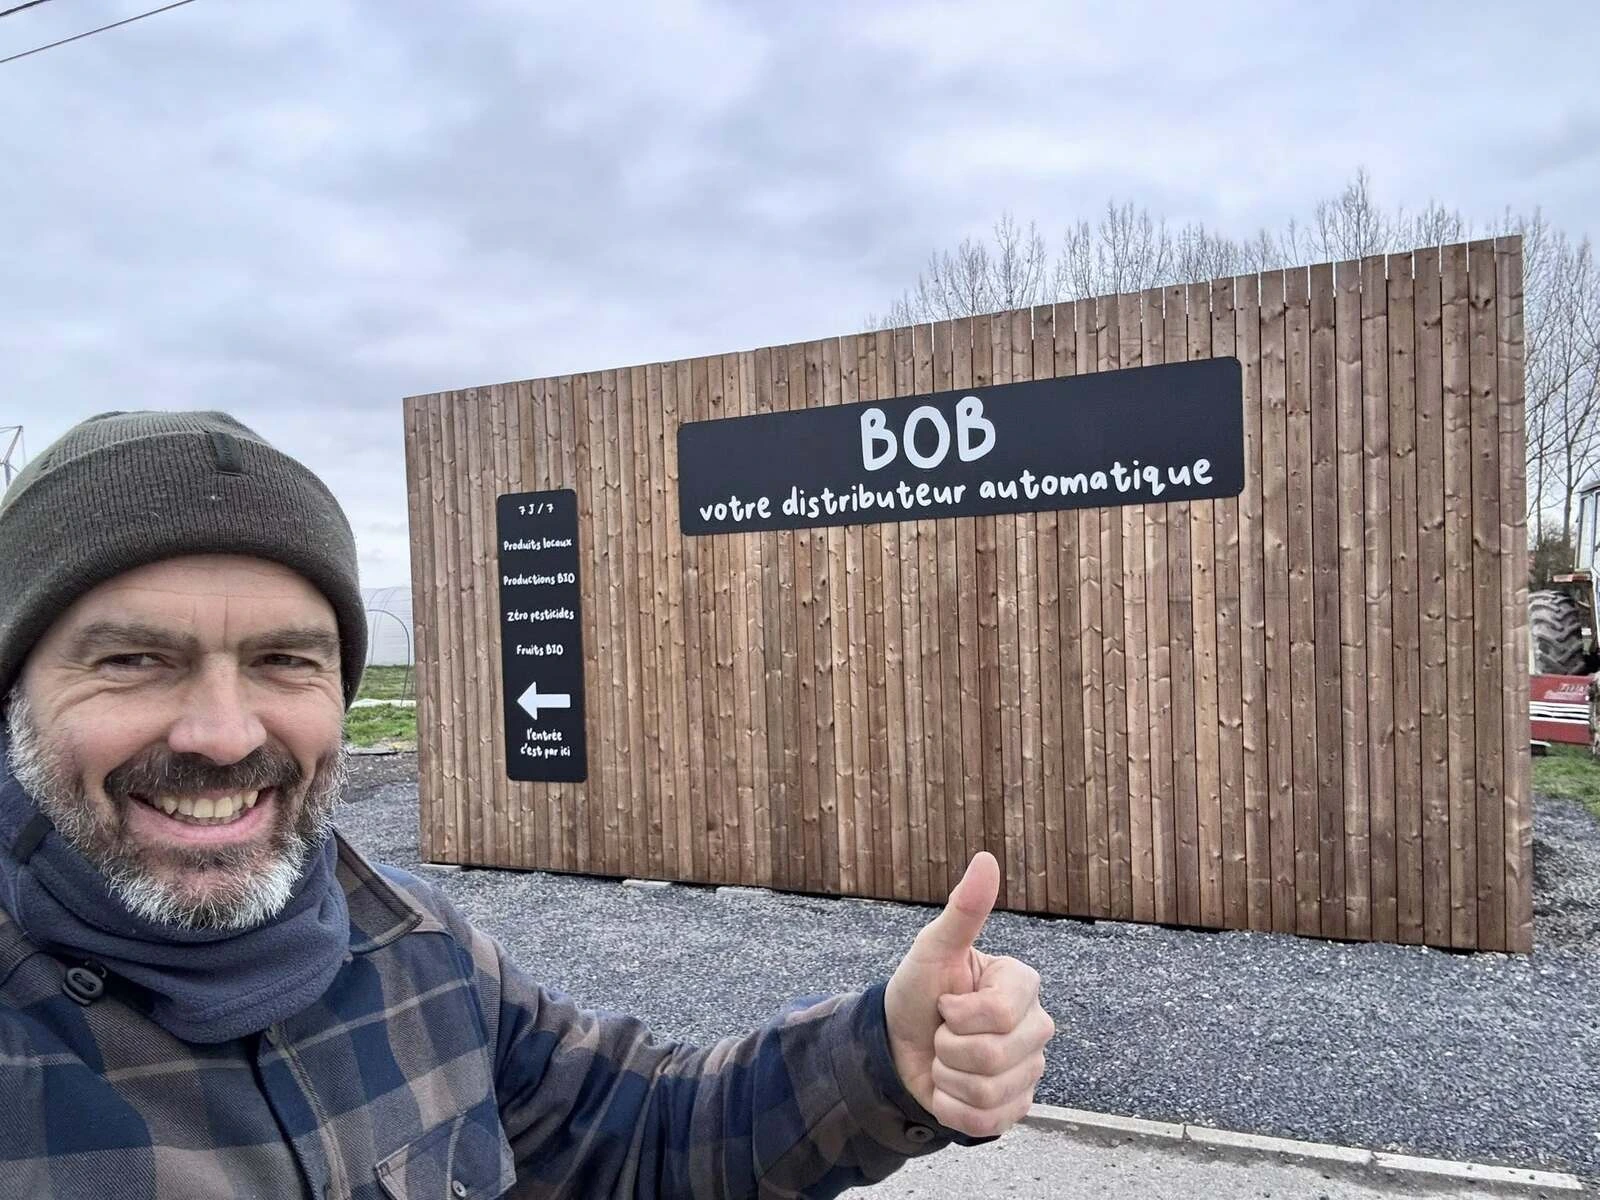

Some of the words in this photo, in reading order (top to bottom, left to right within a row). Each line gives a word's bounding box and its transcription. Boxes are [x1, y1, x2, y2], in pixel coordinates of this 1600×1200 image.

[861, 396, 996, 471] BOB
[700, 496, 772, 522] votre
[782, 480, 967, 516] distributeur
[979, 458, 1213, 500] automatique
[503, 539, 541, 551] Produits
[542, 537, 572, 549] locaux
[503, 574, 556, 586] Productions
[557, 572, 576, 584] BIO
[530, 607, 575, 623] pesticides
[516, 644, 544, 656] Fruits
[545, 643, 564, 656] BIO
[520, 742, 543, 757] c'est
[544, 747, 559, 759] par
[560, 745, 571, 757] ici
